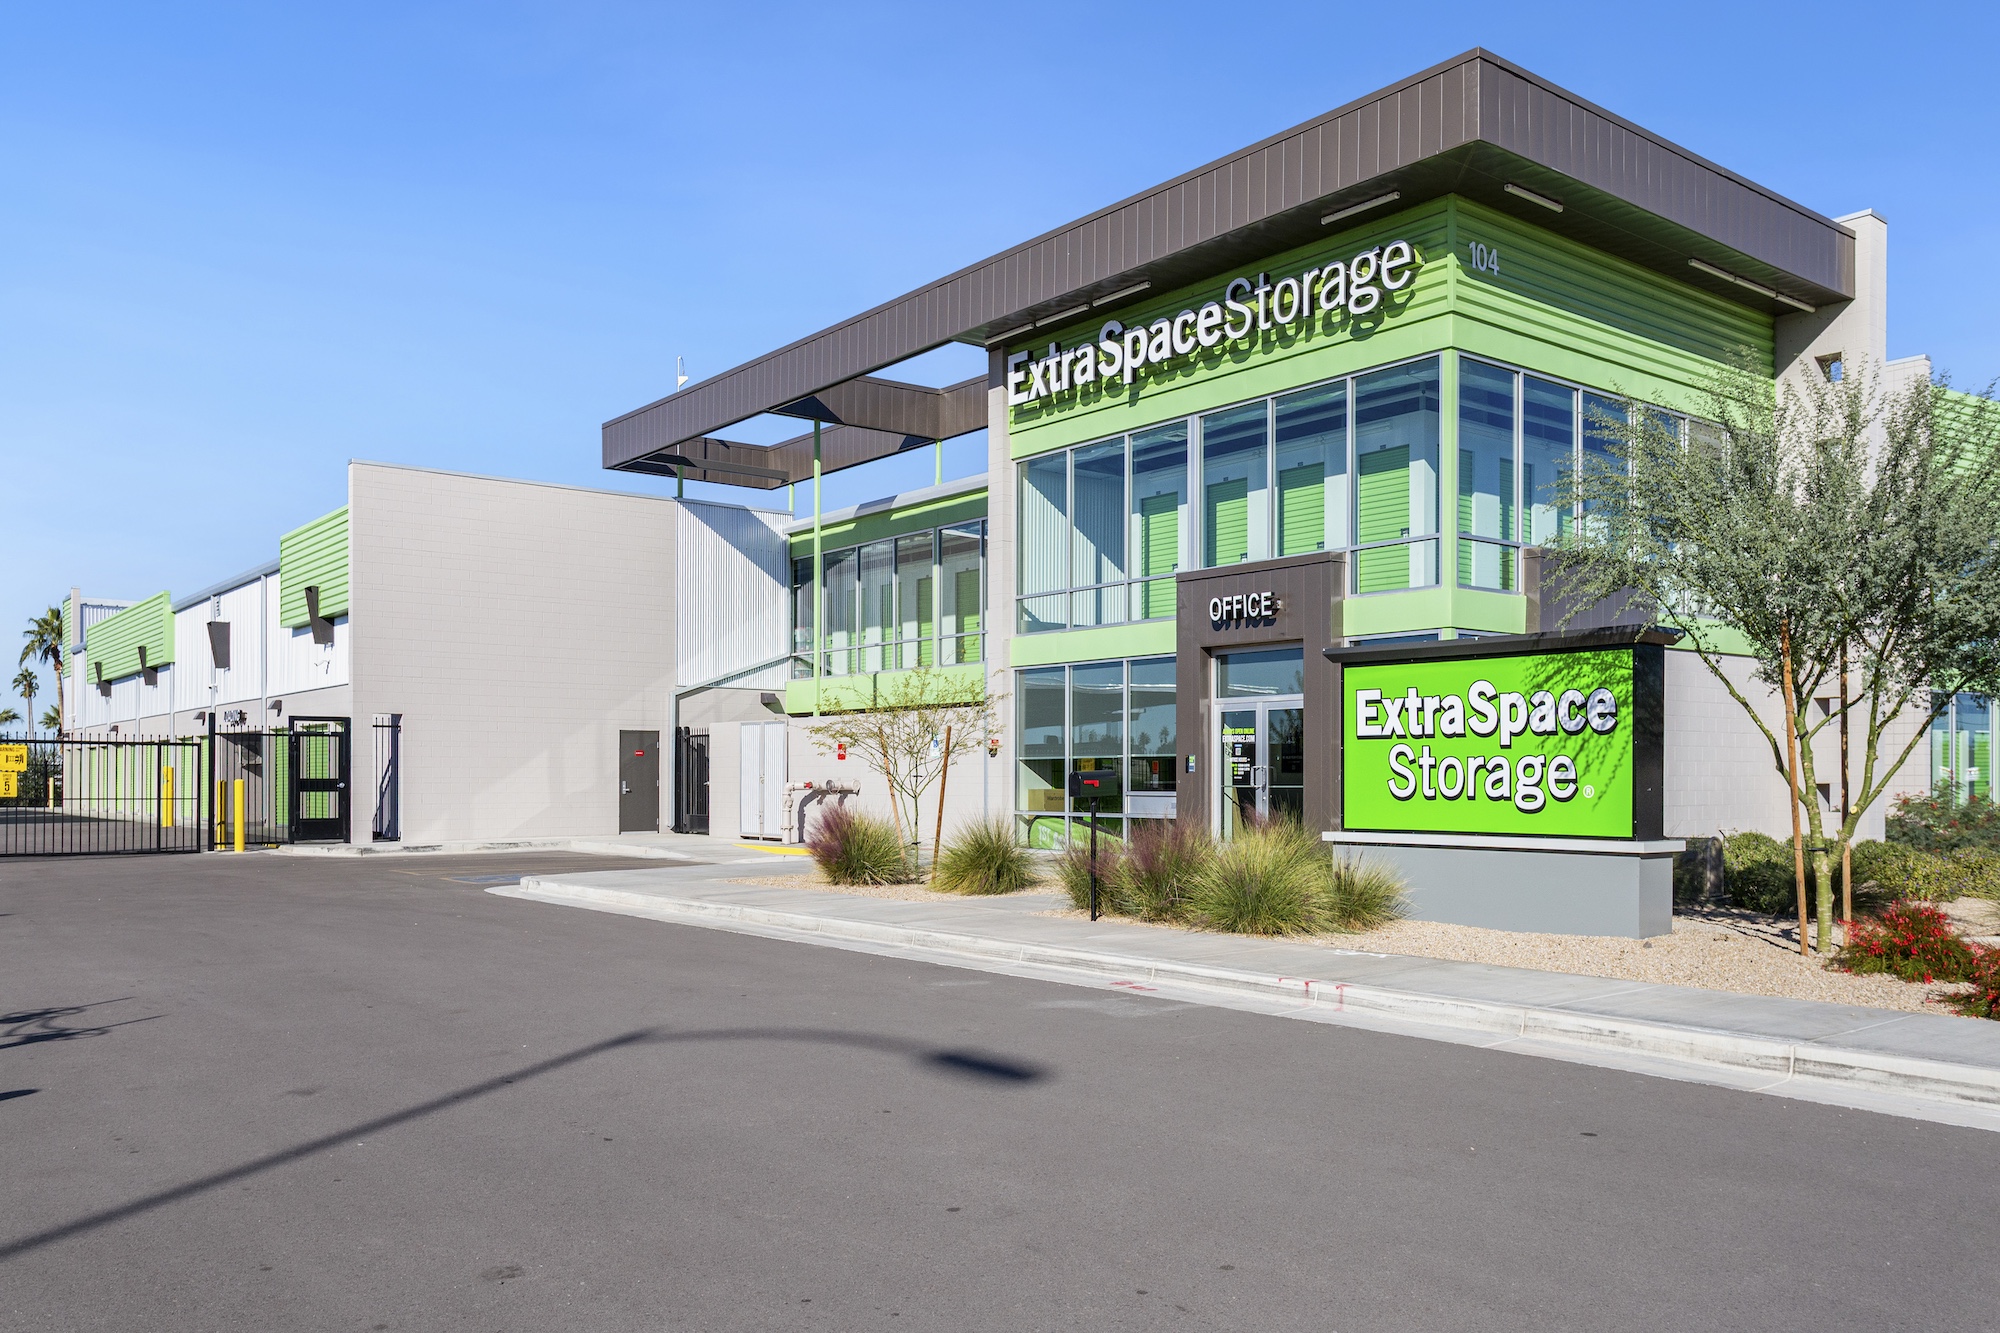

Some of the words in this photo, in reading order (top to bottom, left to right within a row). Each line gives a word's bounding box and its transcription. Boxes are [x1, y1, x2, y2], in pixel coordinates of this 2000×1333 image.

[1469, 241, 1499, 275] 104
[1209, 591, 1273, 621] OFFICE
[5, 781, 10, 791] 5
